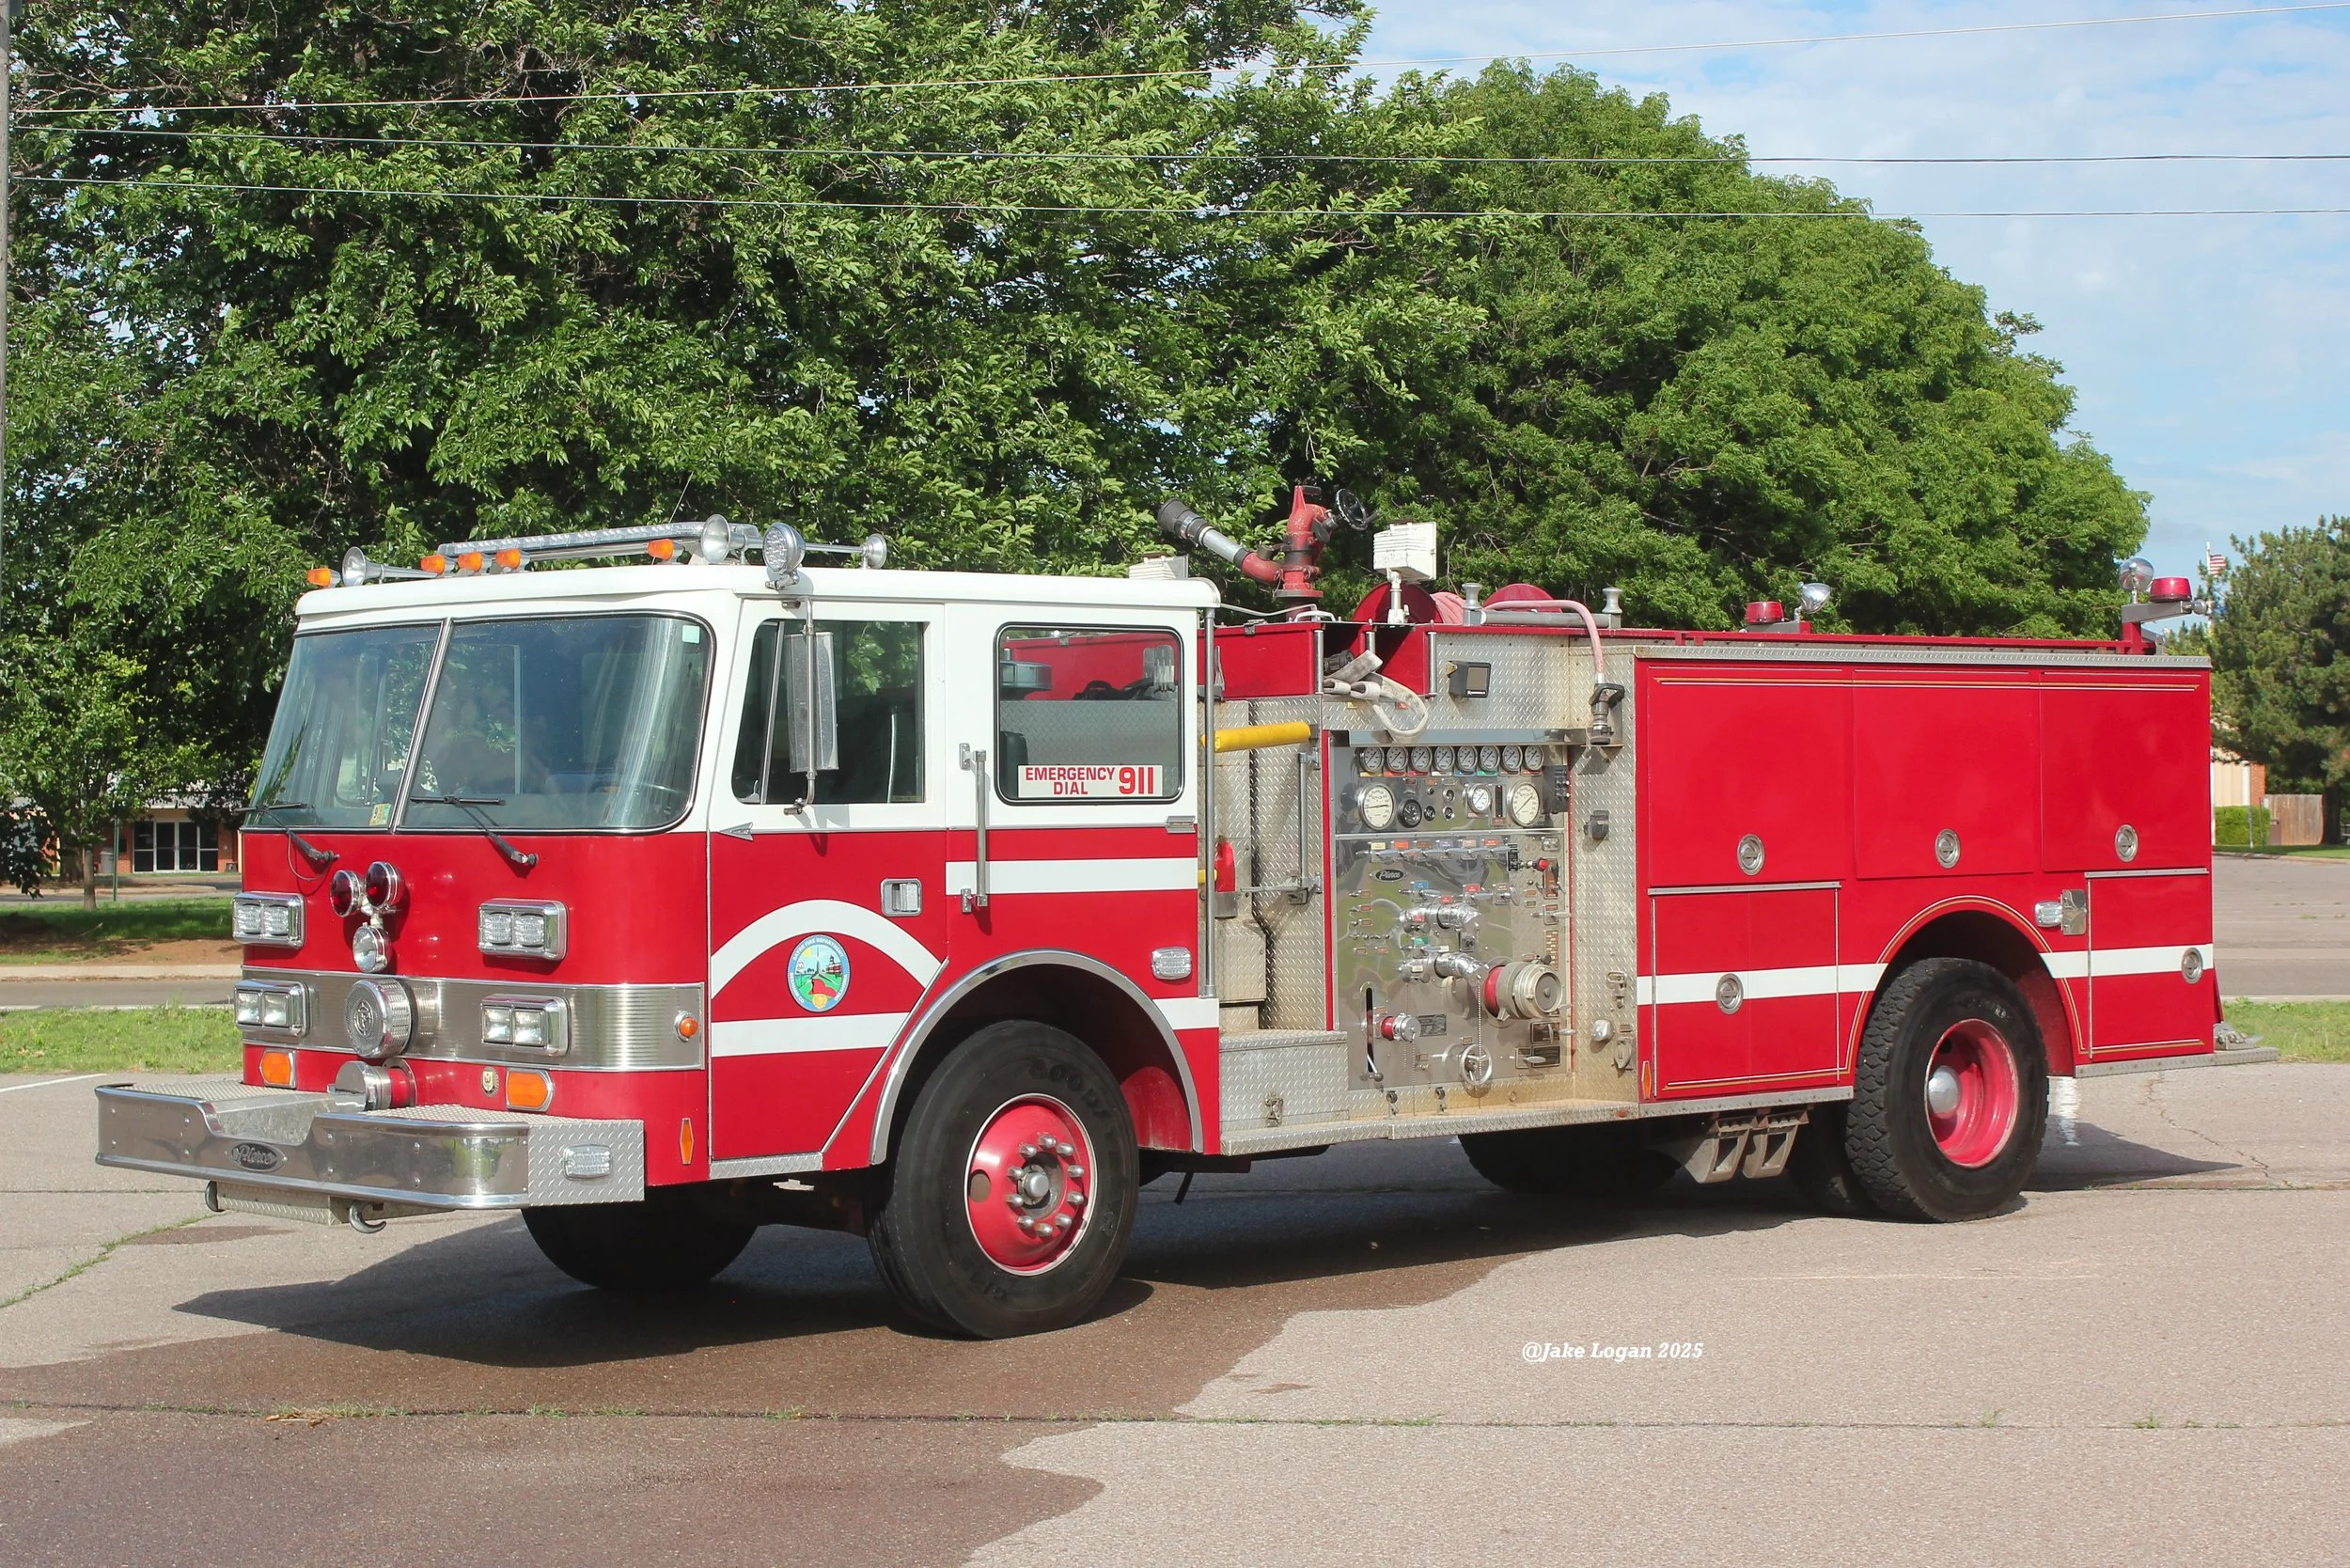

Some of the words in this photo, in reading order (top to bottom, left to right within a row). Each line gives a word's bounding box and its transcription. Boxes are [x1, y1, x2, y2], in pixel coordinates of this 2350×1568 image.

[1026, 767, 1116, 781] EMERGENCY
[1119, 766, 1153, 794] 911
[1053, 781, 1089, 795] DIAL
[805, 938, 816, 947] FIRE
[816, 937, 844, 957] DEPARTMENT
